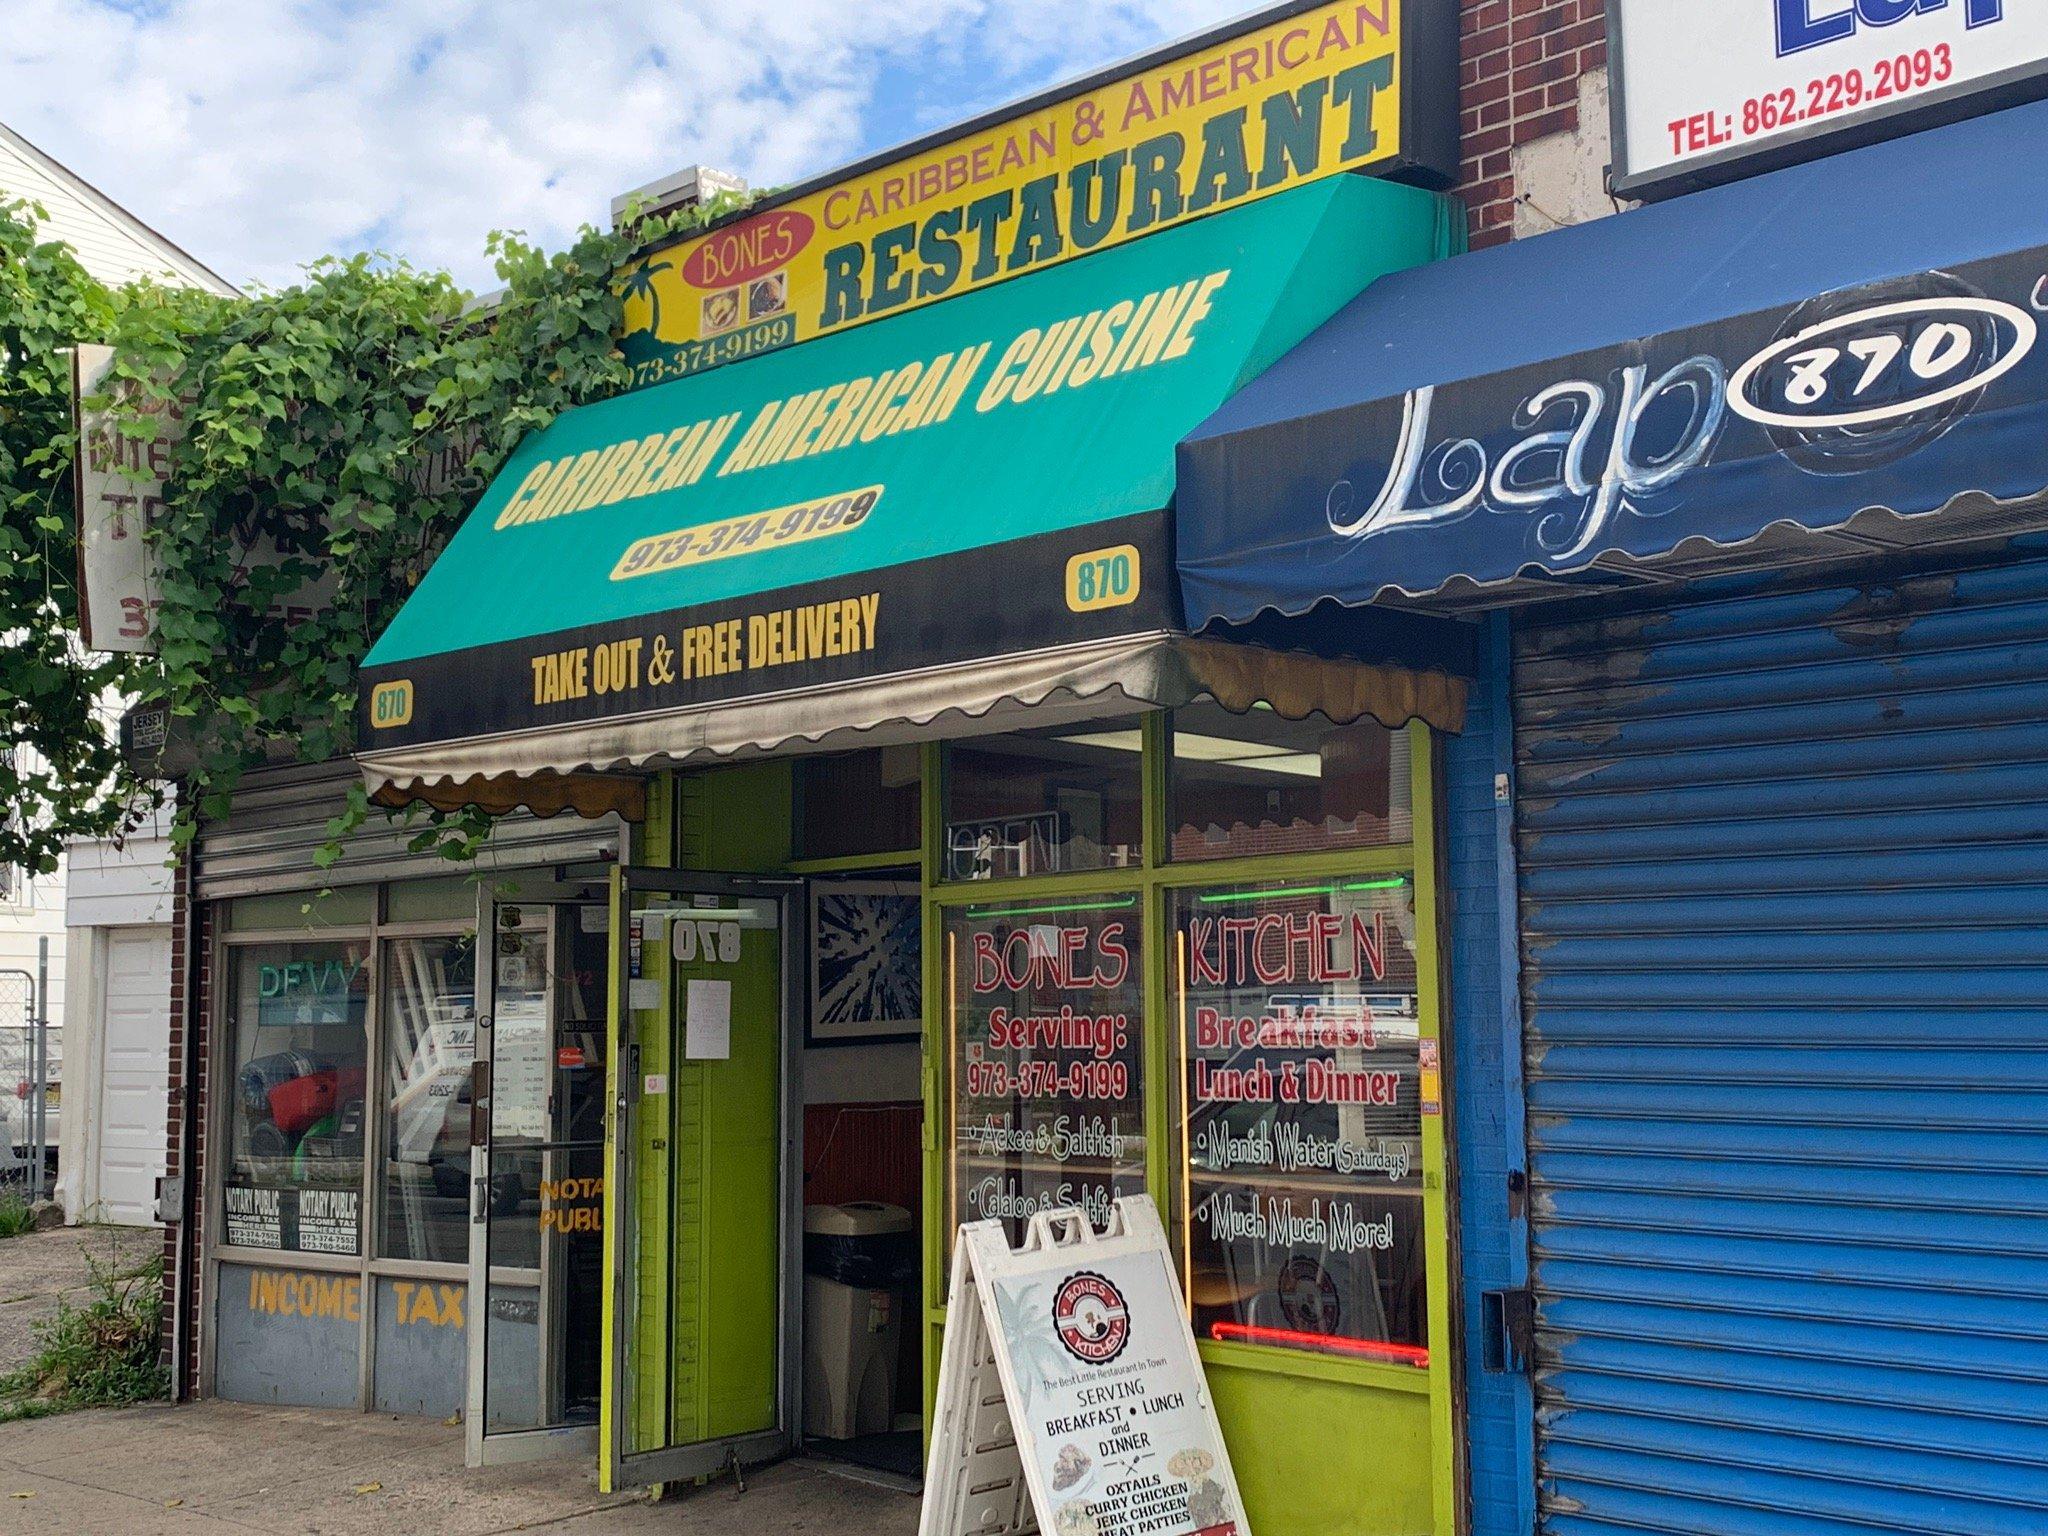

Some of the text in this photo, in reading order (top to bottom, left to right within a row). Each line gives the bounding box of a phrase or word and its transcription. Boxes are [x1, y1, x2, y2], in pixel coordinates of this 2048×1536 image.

[822, 0, 1390, 231] CARIBBEAN & AMERICAN
[1668, 42, 1953, 156] TEL: 862.229.2093
[819, 51, 1395, 328] RESTAURANT
[702, 217, 793, 285] BONES
[1784, 322, 1972, 405] 870
[494, 410, 743, 531] CARIBBEAN
[716, 341, 992, 478] AMERICAN
[975, 269, 1232, 413] CUISINE
[622, 490, 878, 573] 973-374-9199
[1078, 554, 1129, 602] 870
[532, 592, 880, 705] TAKE OUT & FREE DELIVERY
[378, 687, 405, 721] 870
[974, 922, 1129, 993] BONES
[1190, 910, 1384, 986] KITCHEN
[989, 1004, 1127, 1059] Serving:
[1196, 1004, 1377, 1049] Breakfast
[967, 1061, 1128, 1100] 973-374-9199
[1196, 1057, 1400, 1104] Lunch & Dinner
[979, 1112, 1124, 1162] Ackee & Saltfish
[1208, 1118, 1410, 1182] Manish Water (Saturdays)
[226, 1187, 280, 1216] NOTARY PUBLIC
[228, 1213, 280, 1224] INCOME TAX
[300, 1189, 357, 1219] NOTARY PUBLIC
[979, 1176, 1037, 1221] Calaloo
[243, 1222, 266, 1231] HERE
[300, 1217, 357, 1228] INCOME TAX
[301, 1234, 355, 1245] 973-374-7552
[317, 1226, 341, 1235] HERE
[1211, 1191, 1394, 1253] Much Much More!
[250, 1269, 361, 1323] INCOME
[393, 1282, 464, 1329] TAX
[1065, 1281, 1107, 1303] BONES
[1074, 1329, 1122, 1357] KITCHEN
[1043, 1357, 1168, 1391] The Best Little Restaurant In Town
[1076, 1378, 1145, 1408] SERVING
[1046, 1392, 1185, 1437] BREAKFAST LUNCH
[1111, 1421, 1131, 1435] and
[1099, 1432, 1151, 1457] DINNER
[1085, 1481, 1188, 1517] CURRY CHICKEN
[1106, 1474, 1161, 1497] OXTAILS
[1096, 1496, 1187, 1530] JERK CHICKEN
[1138, 1510, 1191, 1533] PATTIES
